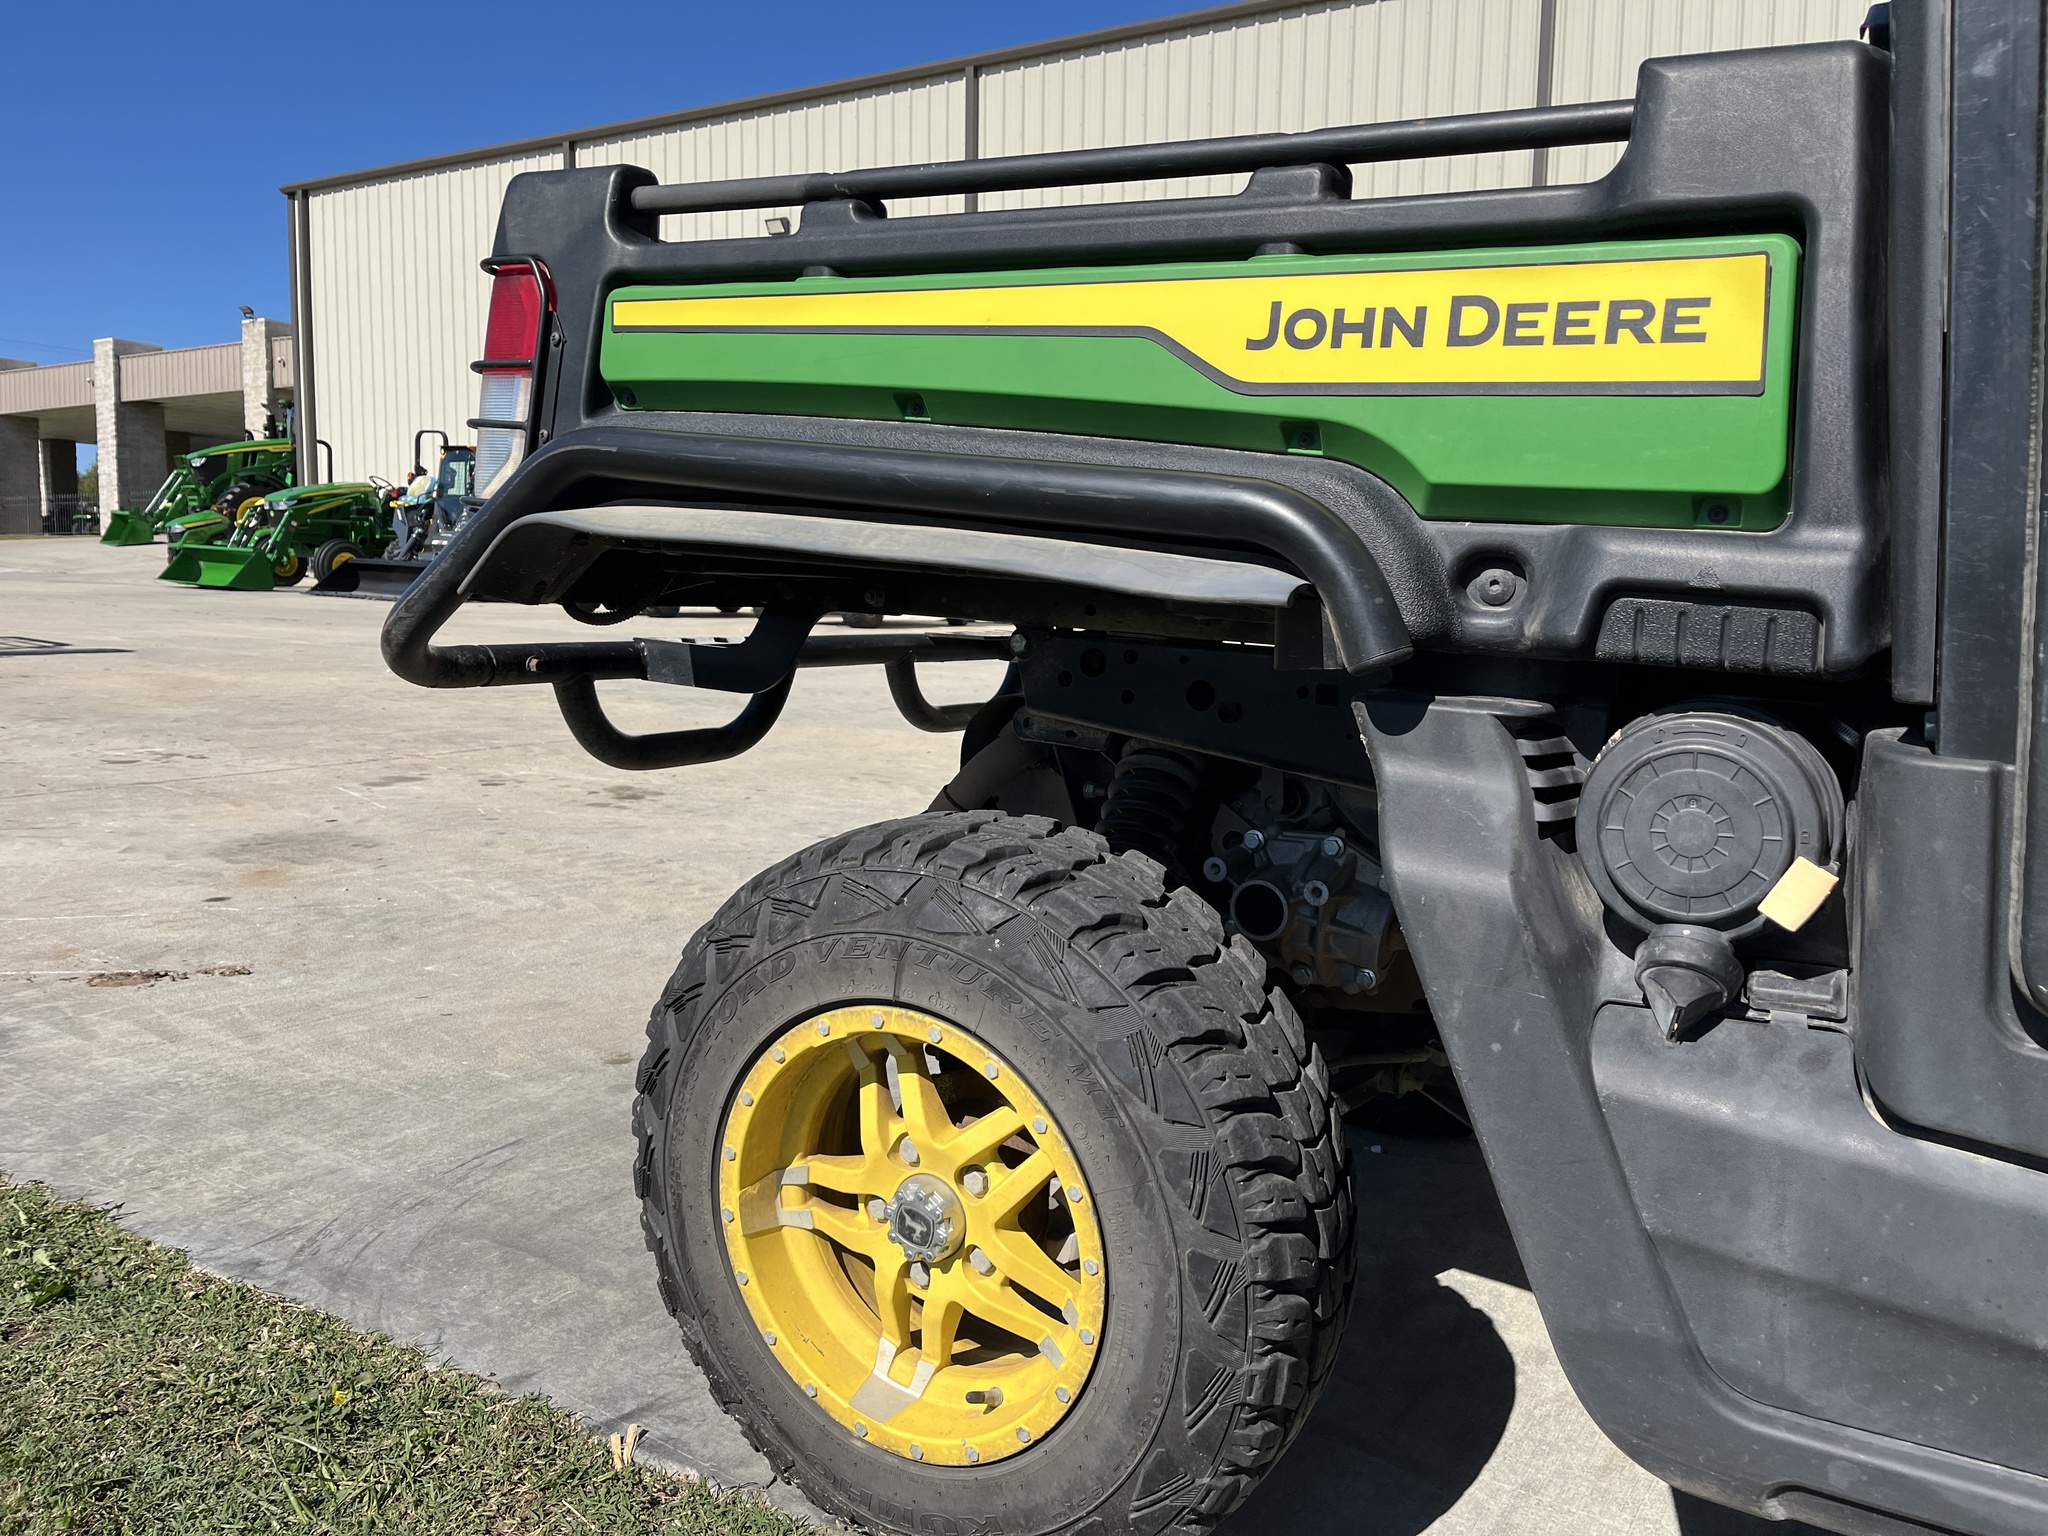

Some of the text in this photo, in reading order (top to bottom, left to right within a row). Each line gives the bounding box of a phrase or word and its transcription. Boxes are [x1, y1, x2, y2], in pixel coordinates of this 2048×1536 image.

[1245, 294, 1711, 351] JOHN DEERE
[698, 951, 798, 1057] ROAD
[812, 936, 1062, 1043] VENTURE
[1066, 1061, 1126, 1128] MT
[1107, 1211, 1124, 1265] TUBELESS
[804, 1451, 1003, 1536] KUMHO
